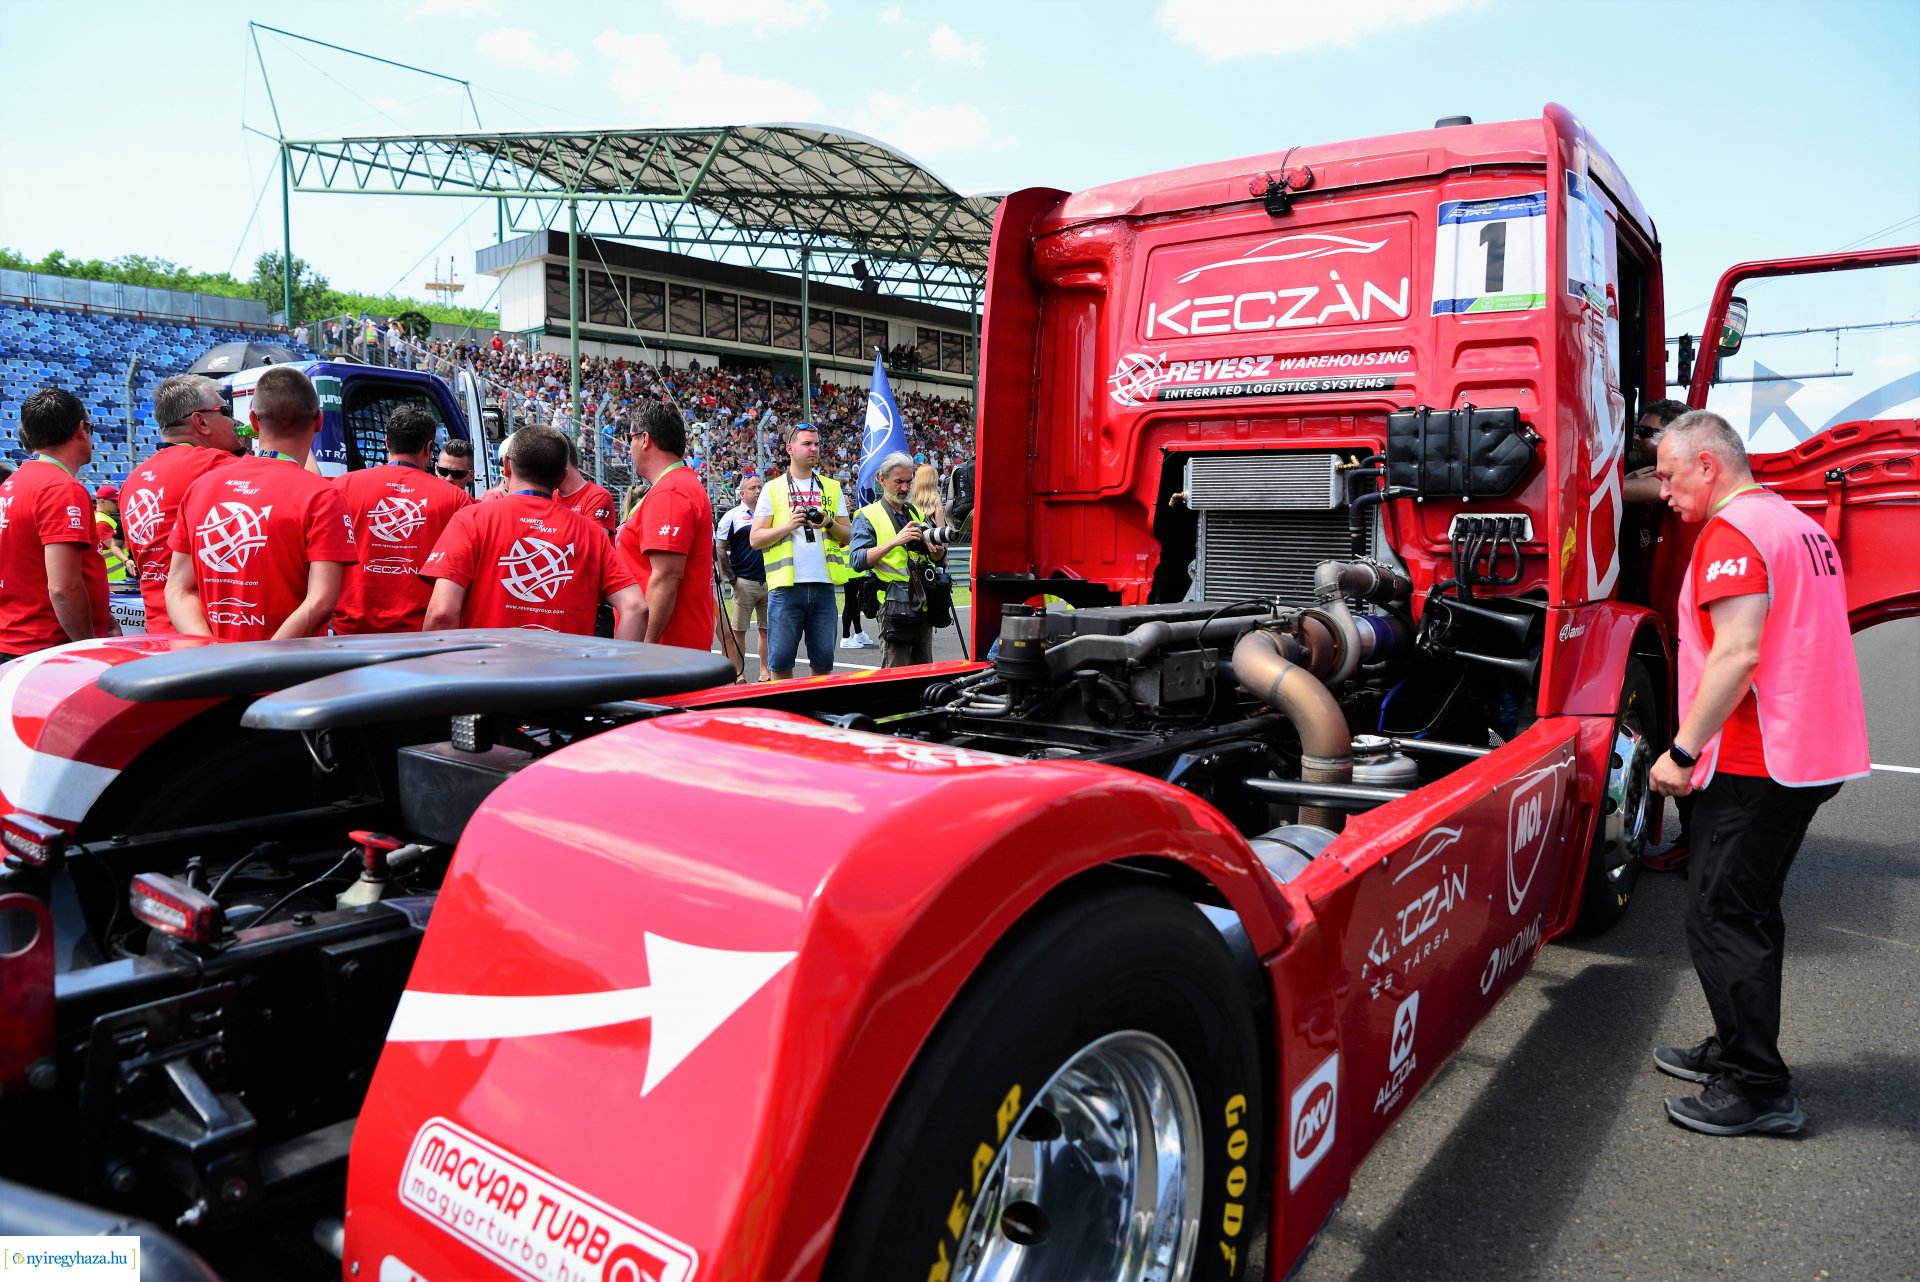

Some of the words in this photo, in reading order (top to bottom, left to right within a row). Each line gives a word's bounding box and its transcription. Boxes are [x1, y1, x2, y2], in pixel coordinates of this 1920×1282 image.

[1480, 221, 1506, 293] 1
[1165, 355, 1275, 384] REVESZ
[1279, 350, 1410, 371] WAREHOUSING
[1165, 383, 1243, 400] INTEGRATED
[1246, 380, 1318, 395] LOGISTICS
[1321, 377, 1385, 391] SYSTEMS
[519, 517, 544, 525] ALWAYS
[540, 526, 557, 534] WAY
[594, 508, 610, 518] #1
[659, 525, 680, 537] #1
[426, 551, 446, 564] #1
[1706, 557, 1748, 582] #41
[1801, 533, 1837, 576] 112
[109, 604, 145, 617] Colum
[1513, 791, 1543, 854] MOL
[1403, 927, 1450, 975] TÁRSA
[1373, 1052, 1417, 1114] ALCOA
[1296, 1089, 1332, 1153] DKV
[419, 1135, 529, 1221] MAGYAR
[1222, 1093, 1248, 1238] GOOD
